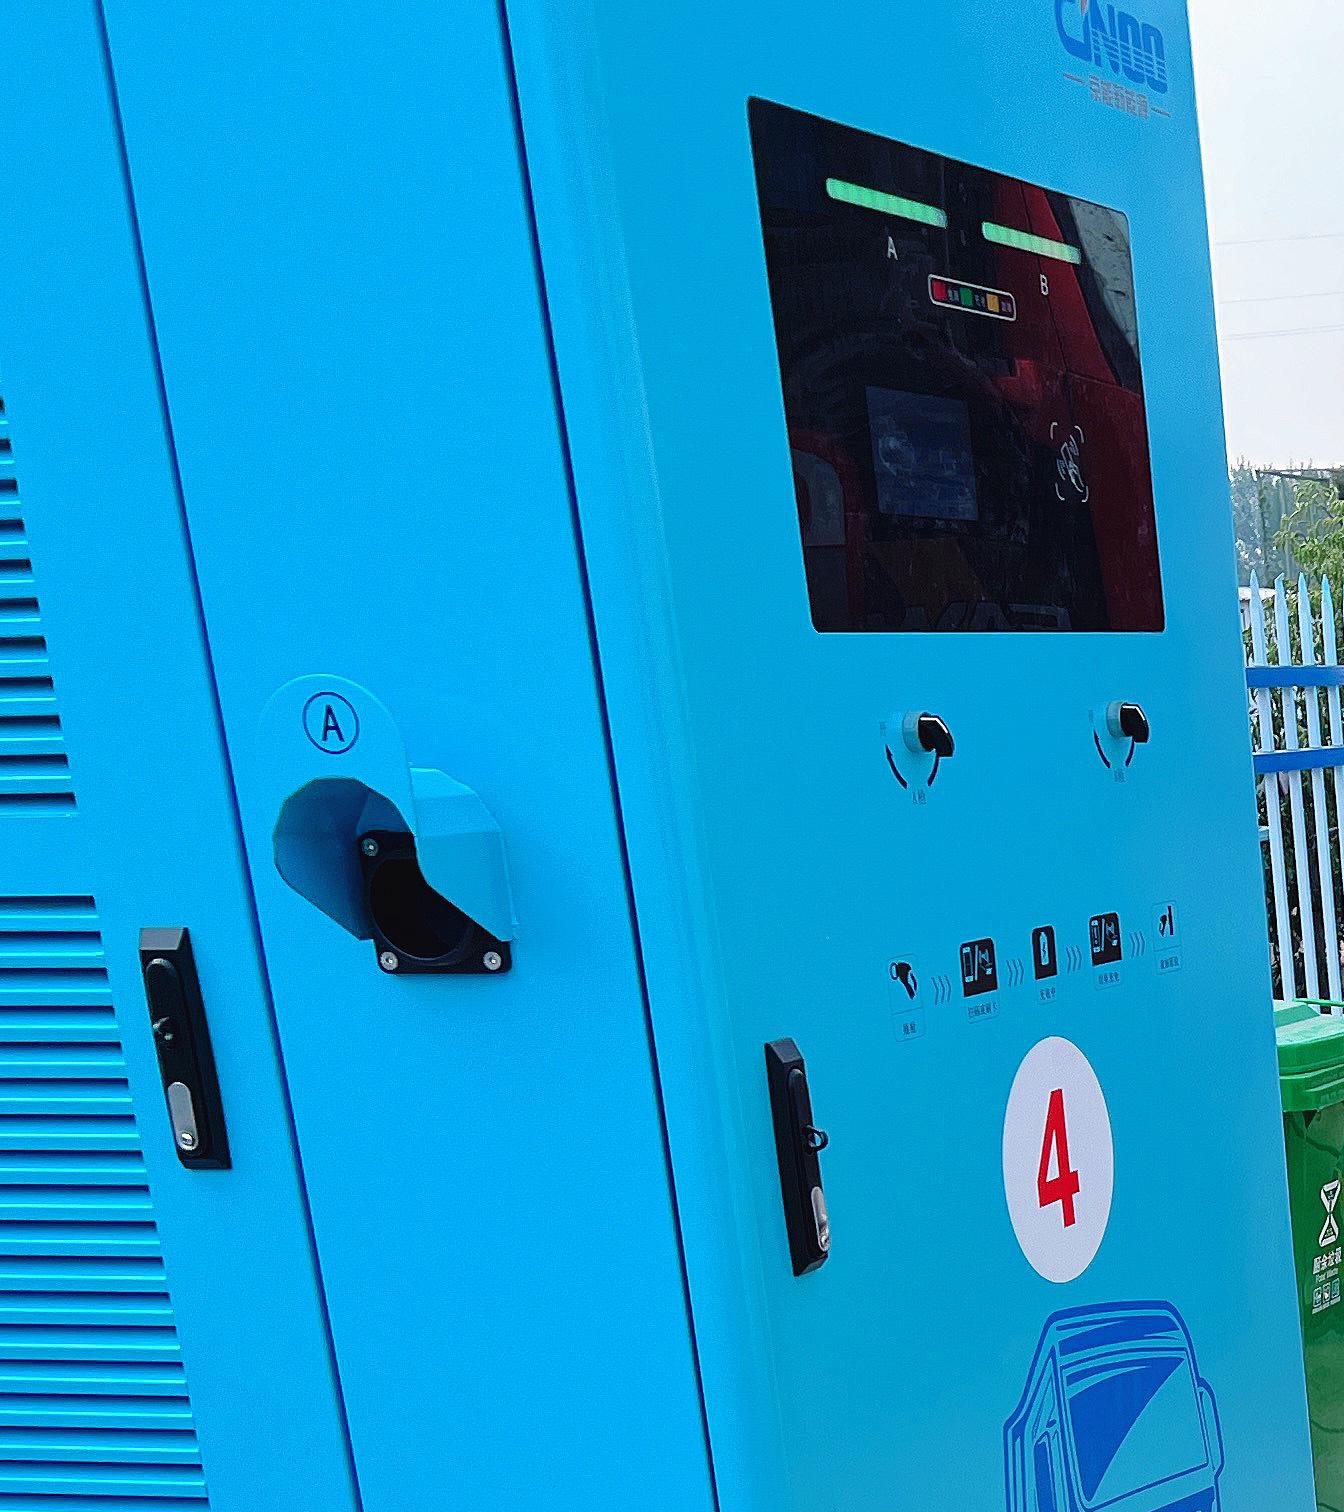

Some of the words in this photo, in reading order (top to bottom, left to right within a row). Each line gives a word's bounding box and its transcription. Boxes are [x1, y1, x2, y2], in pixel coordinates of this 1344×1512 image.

[887, 236, 898, 261] A
[1040, 273, 1049, 296] B
[321, 703, 345, 743] A
[1037, 1088, 1080, 1228] 4
